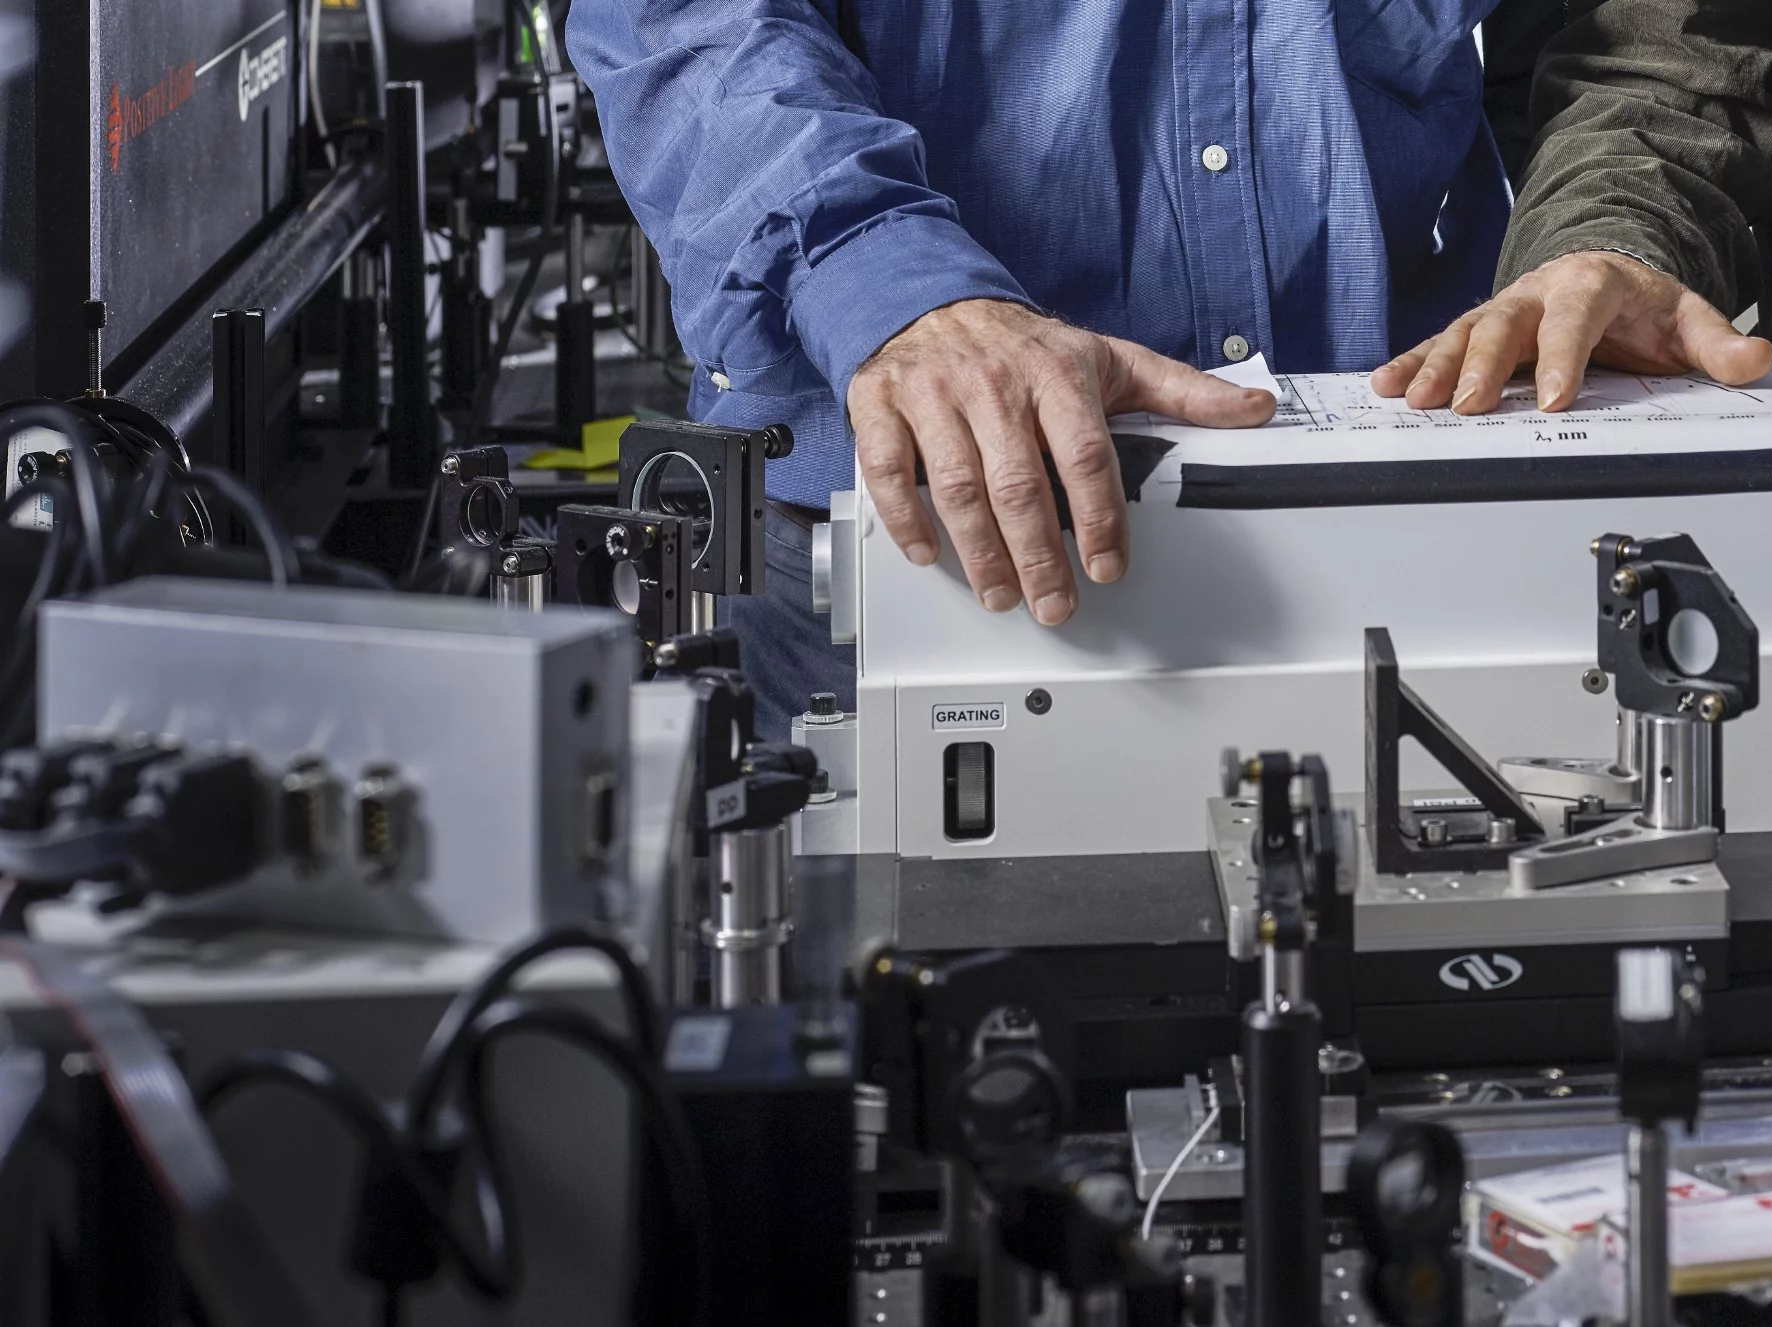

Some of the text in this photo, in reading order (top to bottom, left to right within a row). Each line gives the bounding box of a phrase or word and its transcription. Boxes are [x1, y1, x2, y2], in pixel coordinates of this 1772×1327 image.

[124, 80, 166, 144] POSITIVE
[1558, 431, 1588, 440] nm
[936, 709, 1000, 723] GRATING
